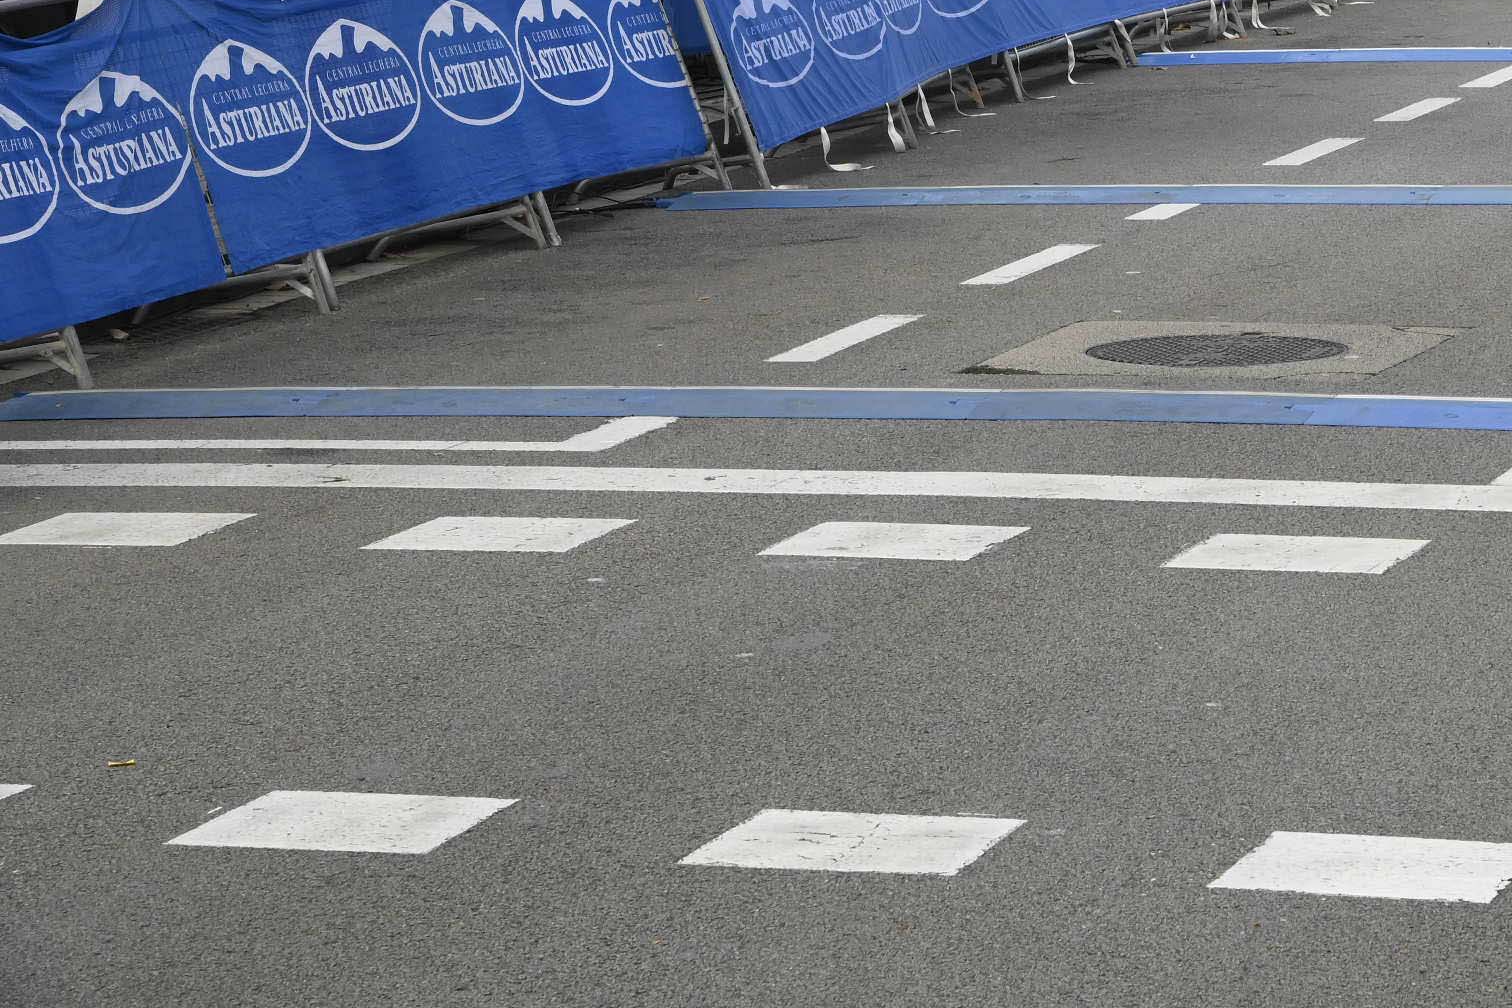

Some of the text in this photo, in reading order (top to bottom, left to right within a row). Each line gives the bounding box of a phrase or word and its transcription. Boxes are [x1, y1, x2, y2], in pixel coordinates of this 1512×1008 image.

[428, 50, 520, 99] ASTURIANA
[523, 34, 609, 81] ASTURIANA
[201, 97, 306, 151] ASTURIANA
[316, 73, 416, 125] ASTURIANA
